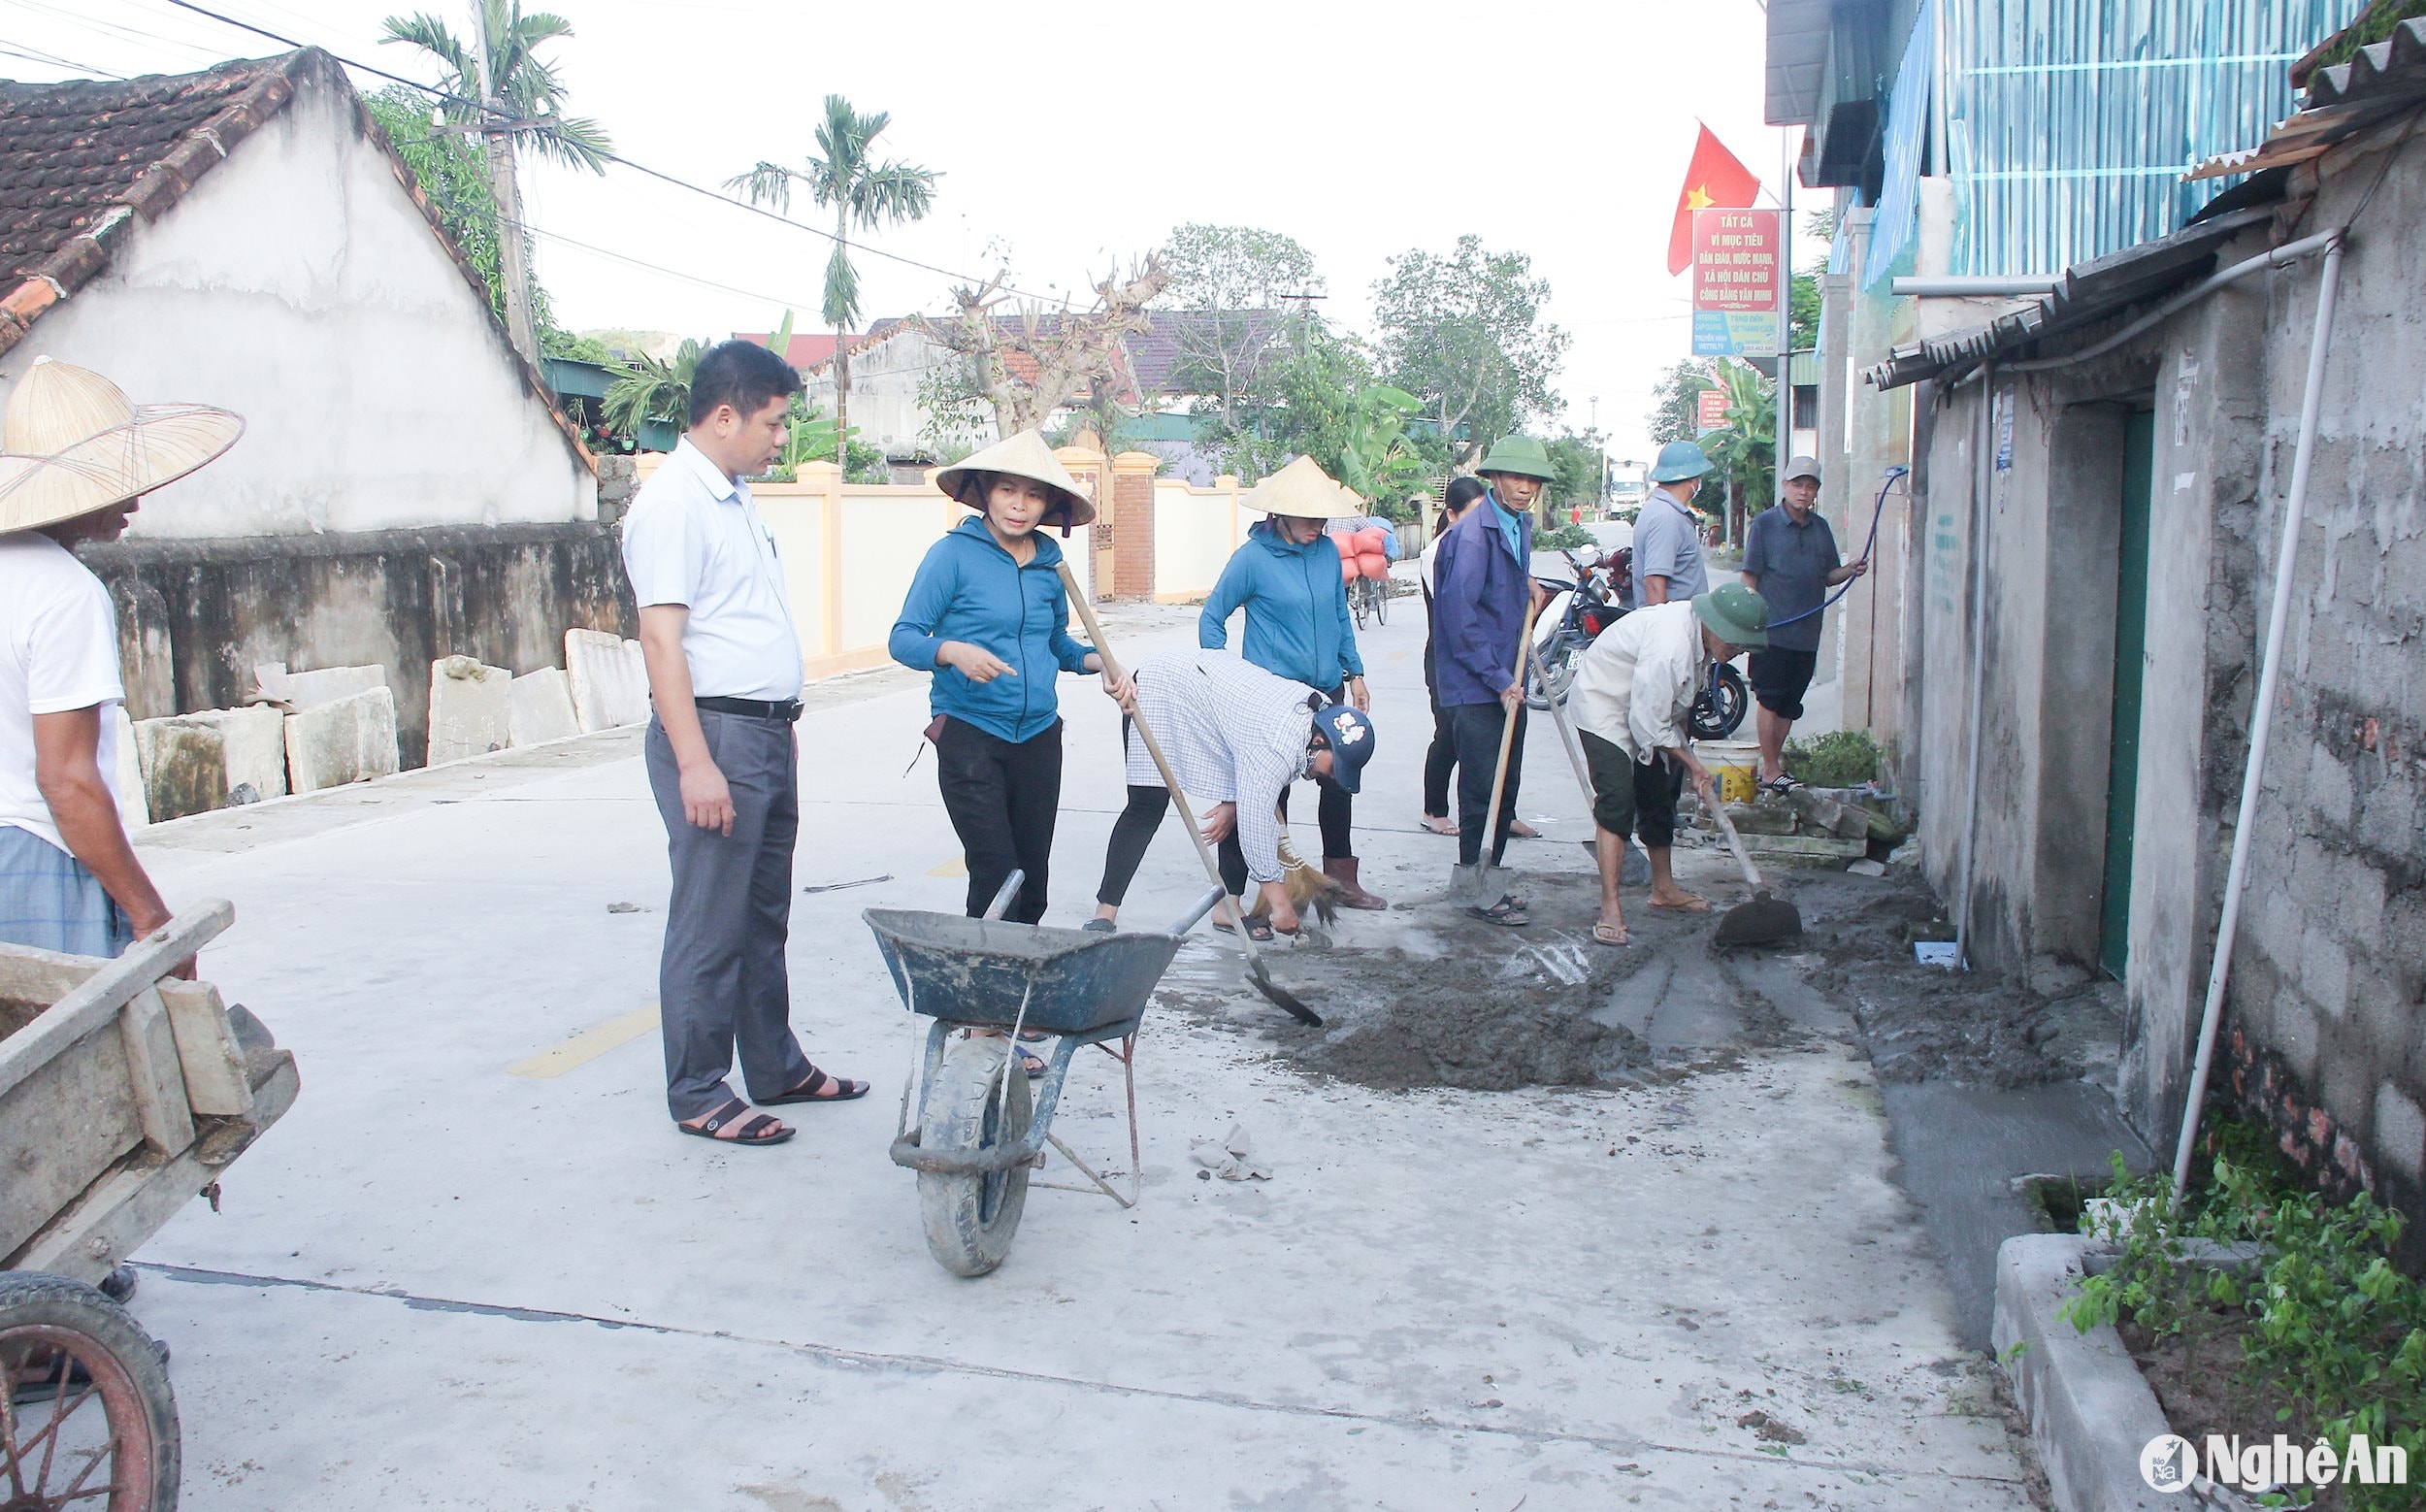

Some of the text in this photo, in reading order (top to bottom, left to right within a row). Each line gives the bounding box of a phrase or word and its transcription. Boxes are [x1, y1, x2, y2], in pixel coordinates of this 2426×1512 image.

[1721, 212, 1754, 228] TẤT CẢ
[1711, 232, 1763, 248] VÌ MỤC TIÊU
[1699, 250, 1713, 264] DÂN
[1733, 249, 1752, 264] NƯỚC
[1704, 267, 1769, 285] XÃ HỘI DÂN CHỦ
[1700, 285, 1772, 302] CÔNG BẰNG VĂN MINH
